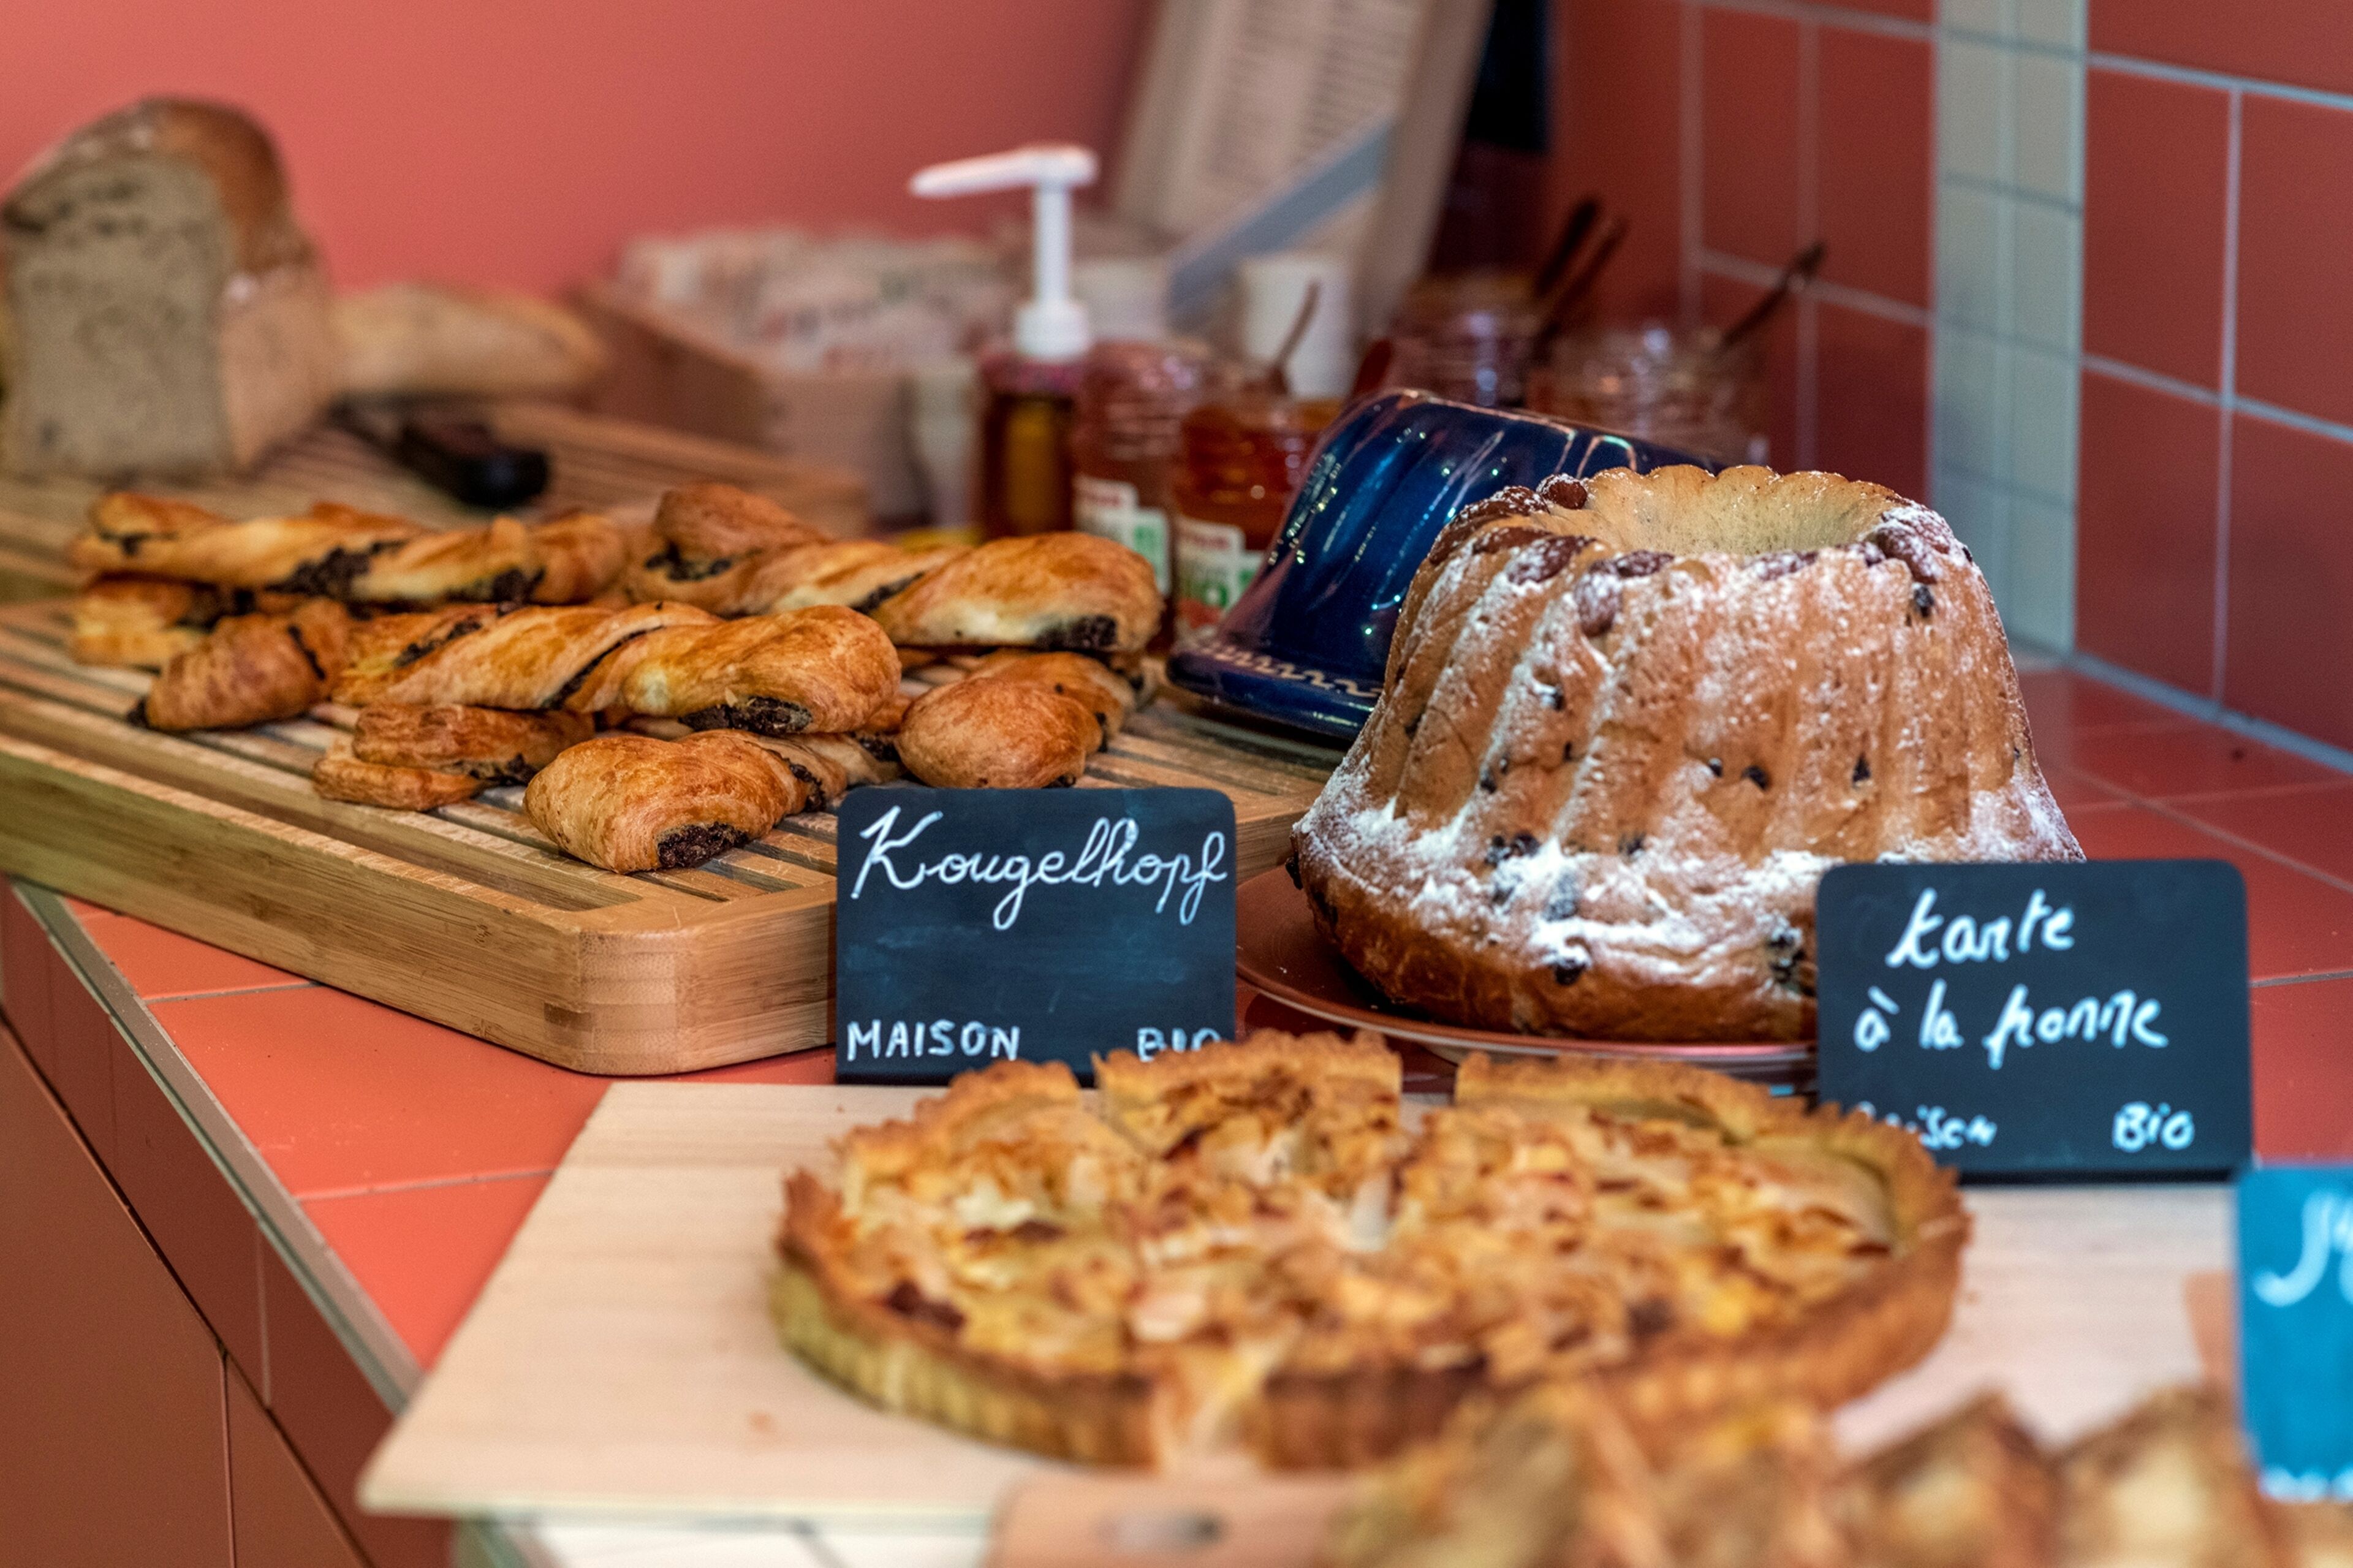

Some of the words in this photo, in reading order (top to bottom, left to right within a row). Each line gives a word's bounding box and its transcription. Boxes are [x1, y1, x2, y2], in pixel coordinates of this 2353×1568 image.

[849, 804, 1229, 931] Kougelhopf
[846, 1018, 1021, 1062] MAISON
[1854, 985, 1900, 1052] à
[1919, 978, 1965, 1051] la
[2112, 1100, 2196, 1154] Bio
